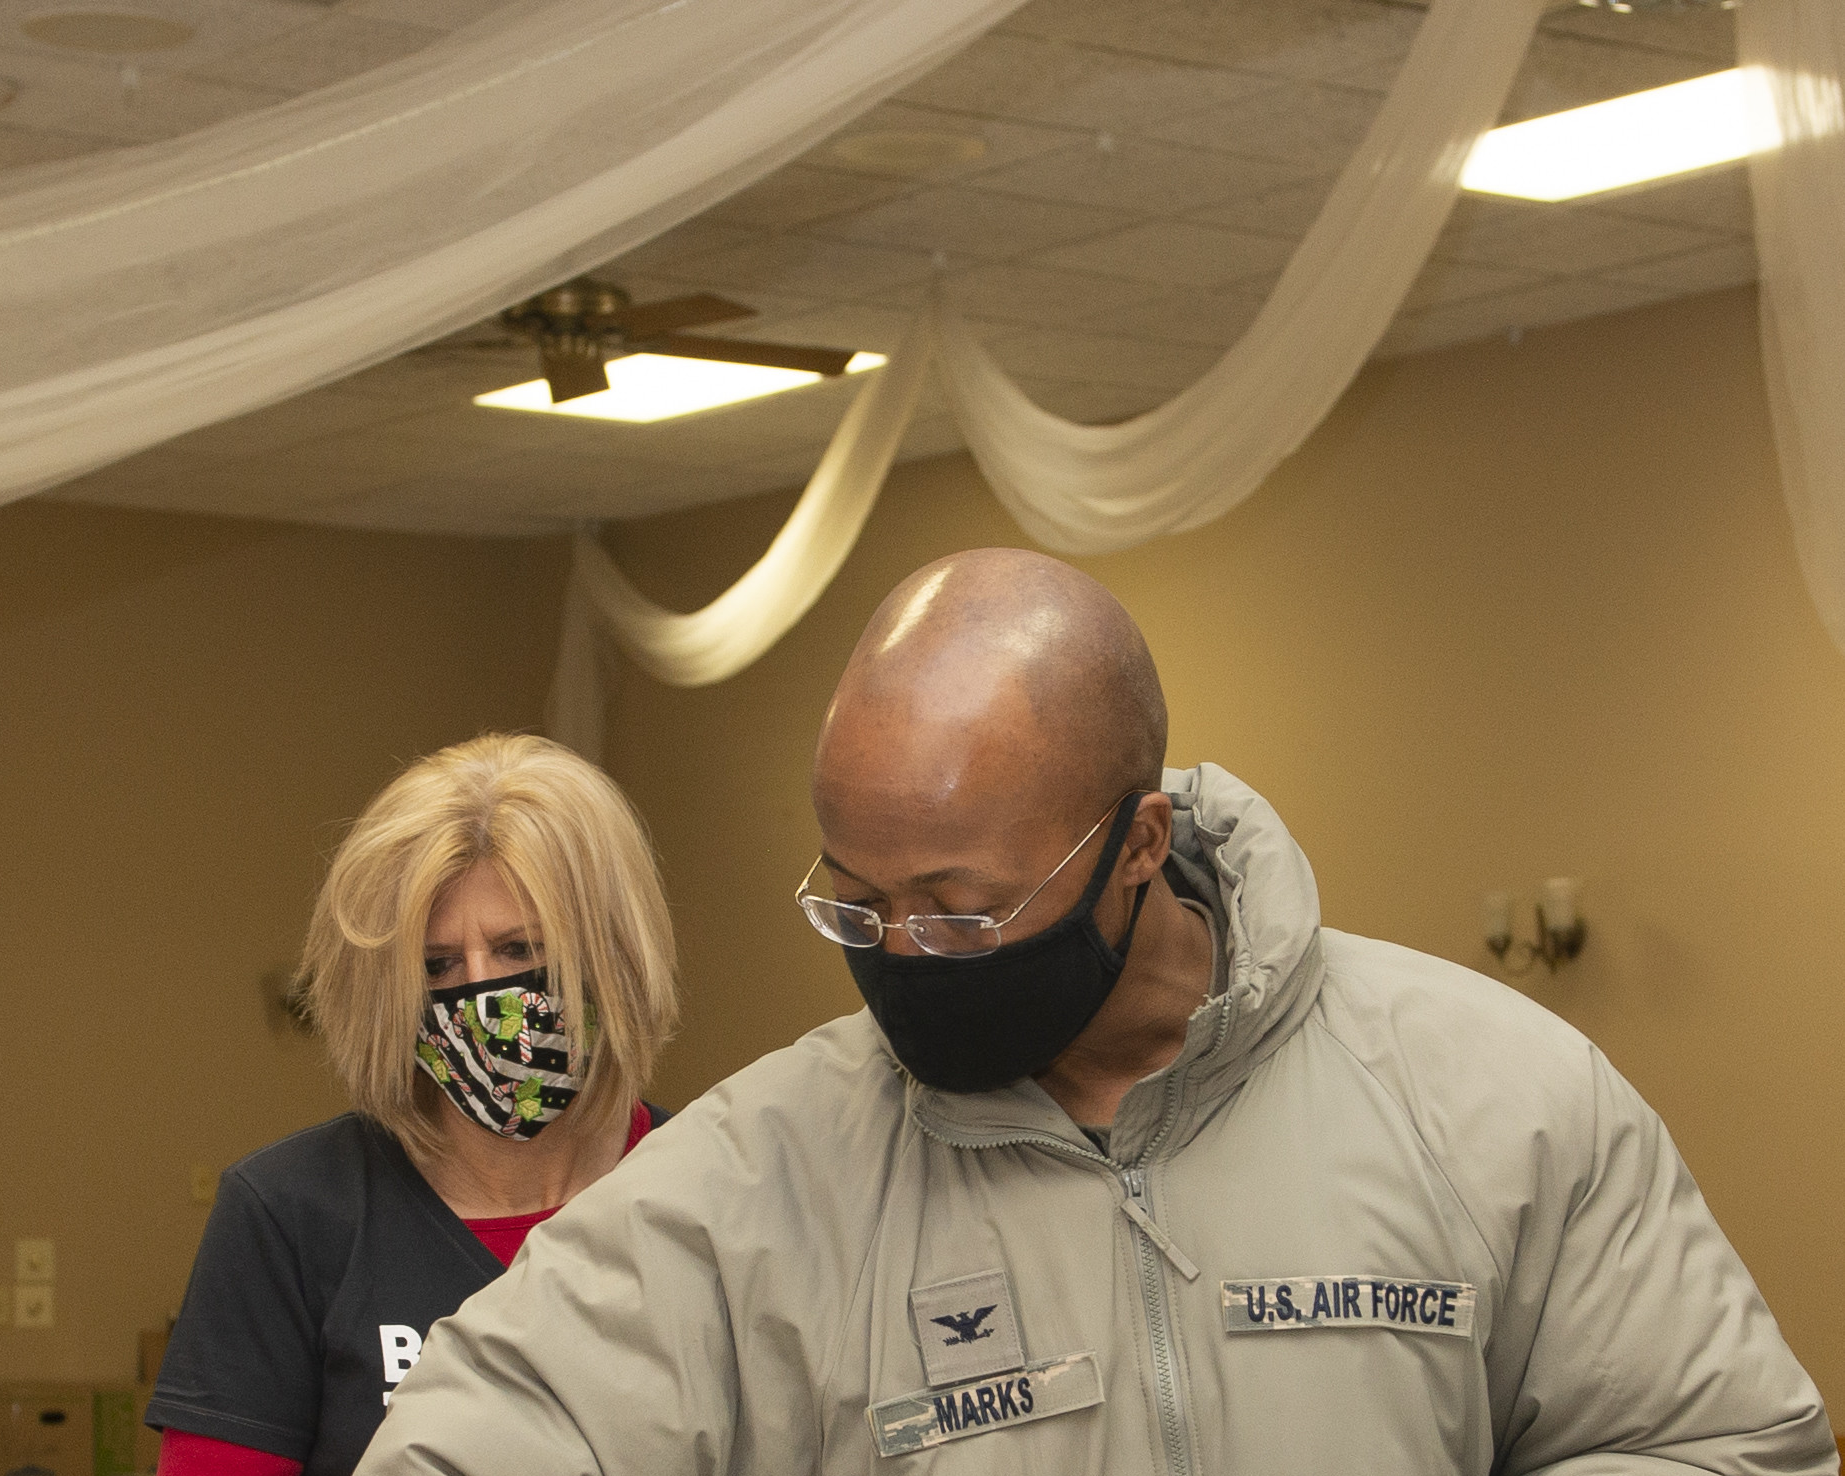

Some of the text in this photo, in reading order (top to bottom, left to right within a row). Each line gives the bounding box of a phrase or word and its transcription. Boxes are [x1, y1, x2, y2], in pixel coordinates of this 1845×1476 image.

[1247, 1281, 1458, 1326] U.S. AIR FORCE
[934, 1376, 1035, 1435] MARKS
